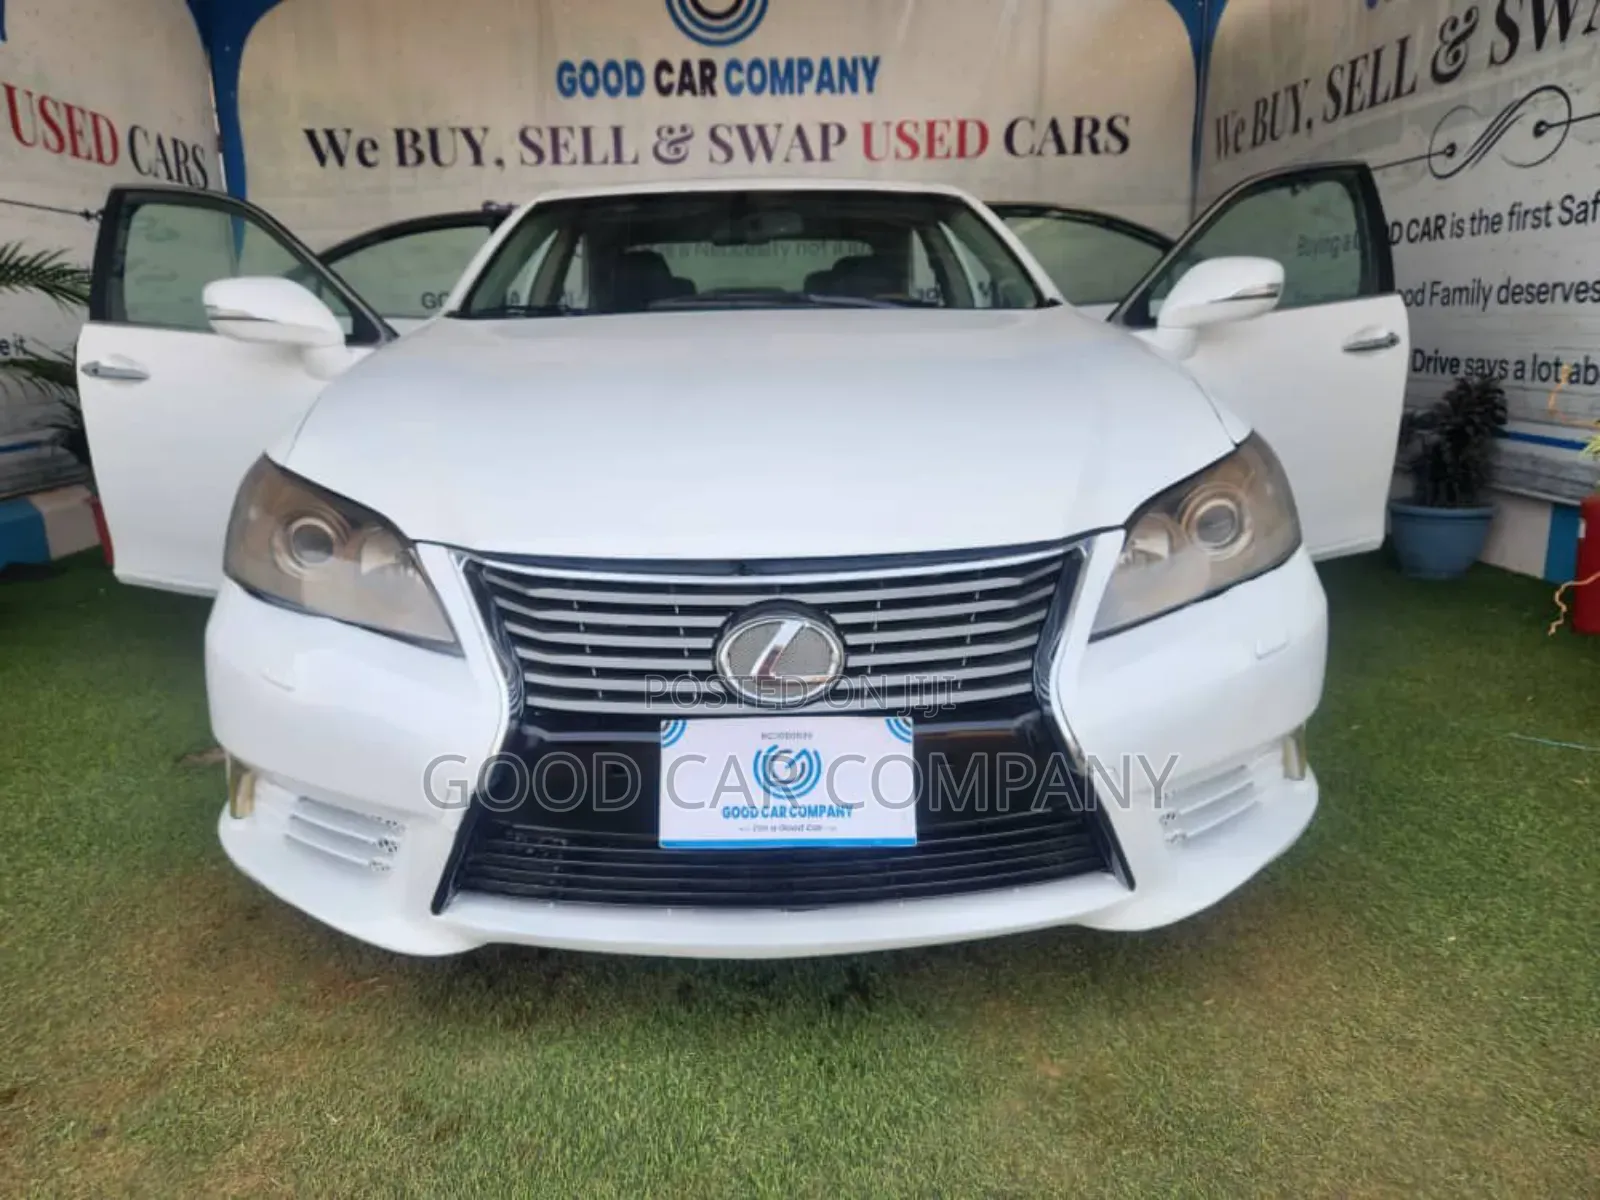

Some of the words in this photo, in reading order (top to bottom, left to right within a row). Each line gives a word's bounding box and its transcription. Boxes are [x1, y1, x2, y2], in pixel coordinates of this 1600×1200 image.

[556, 59, 645, 98] GOOD
[654, 58, 717, 97] CAR
[724, 56, 881, 95] COMPANY
[1214, 108, 1246, 160] We
[1250, 77, 1314, 150] BUY,
[1321, 34, 1418, 125] SELL
[1430, 4, 1480, 85] &
[2, 81, 119, 168] USED
[127, 124, 209, 190] CARS
[303, 127, 380, 169] We
[393, 126, 506, 172] BUY,
[518, 125, 641, 166] SELL
[652, 123, 695, 165] &
[708, 121, 847, 165] SWAP
[861, 117, 990, 163] USED
[1003, 114, 1130, 158] CARS
[1406, 213, 1446, 244] CAR
[1450, 211, 1465, 239] is
[1470, 206, 1503, 237] the
[1508, 200, 1553, 233] first
[1429, 276, 1493, 313] Family
[1411, 348, 1461, 376] Drive
[1463, 356, 1509, 383] says
[1513, 359, 1526, 381] a
[1530, 353, 1562, 384] lot
[722, 805, 759, 819] GOOD
[761, 804, 787, 819] CAR
[789, 803, 854, 819] COMPANY
